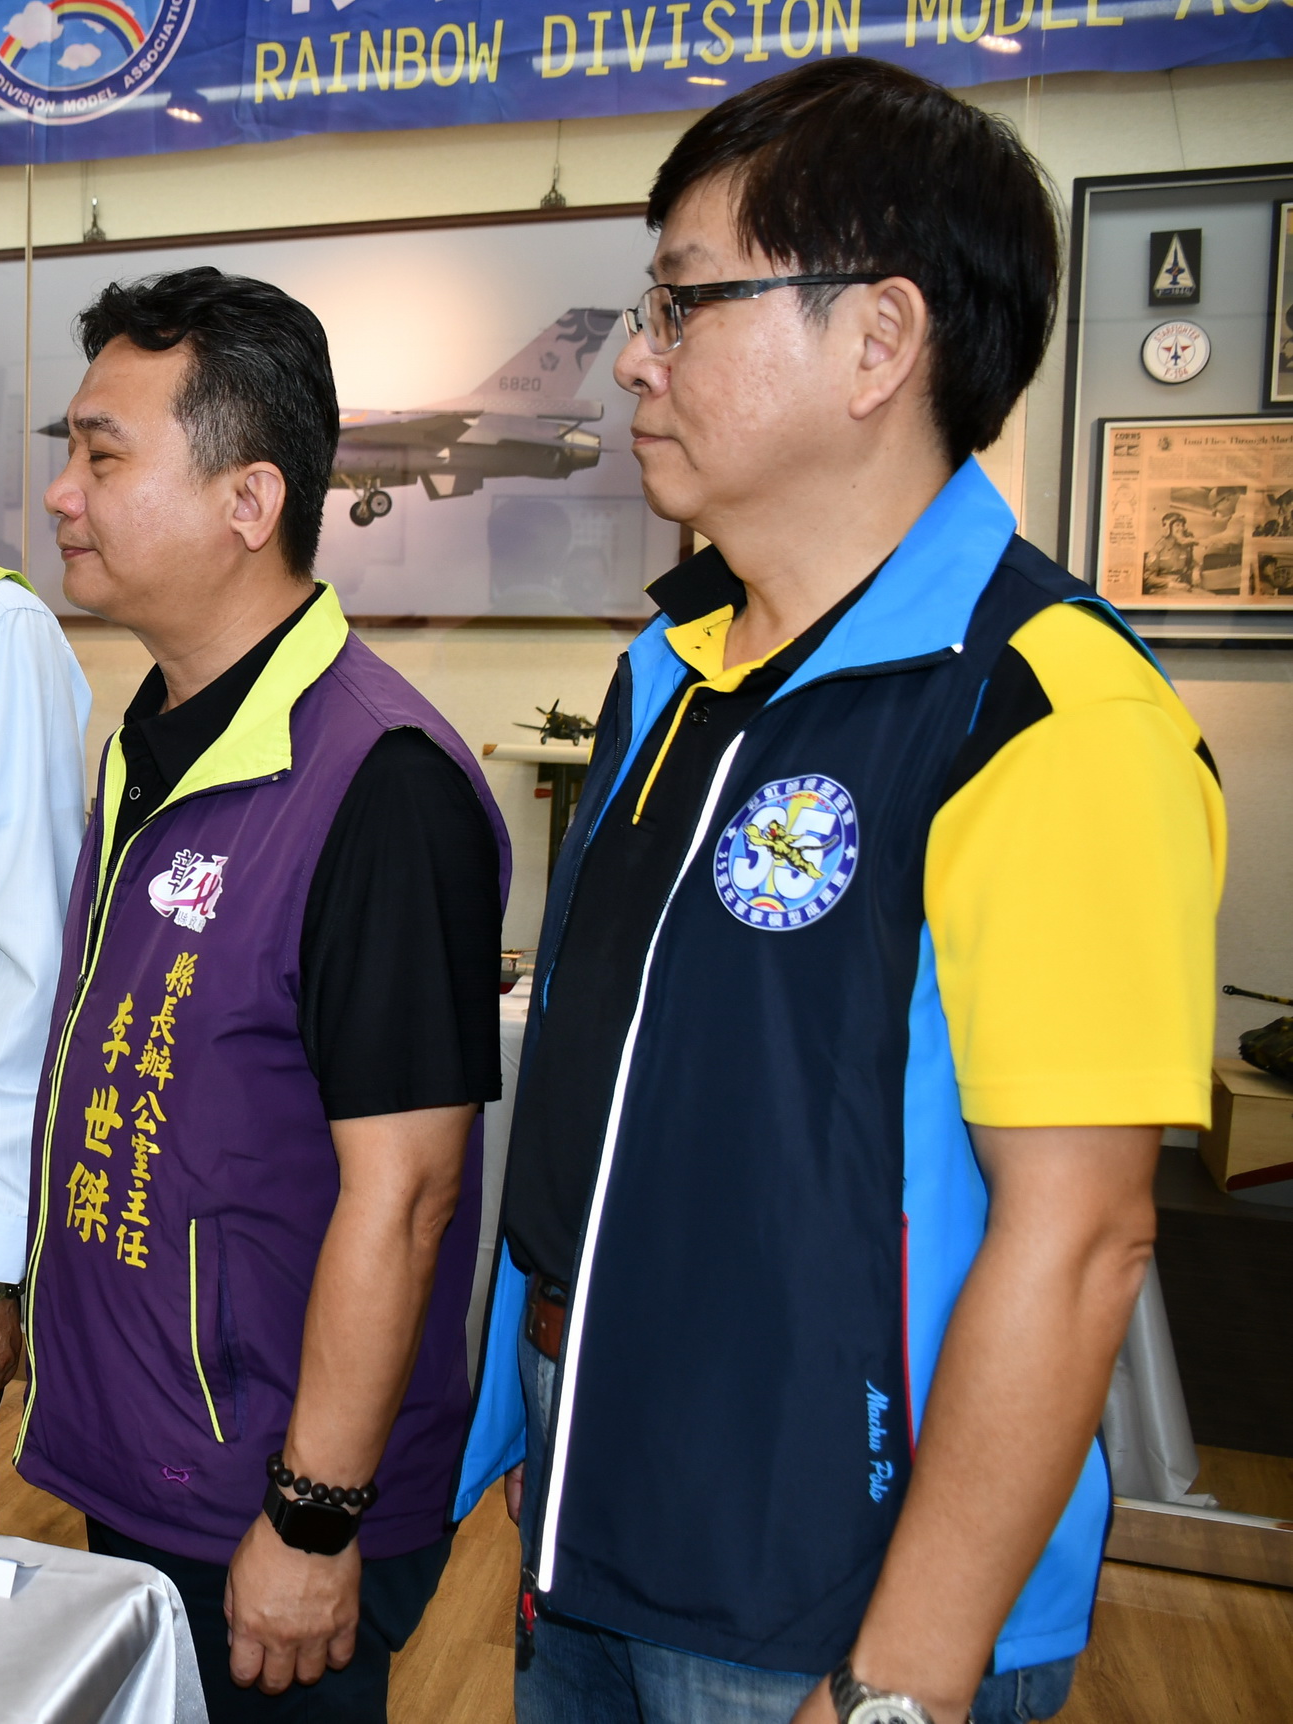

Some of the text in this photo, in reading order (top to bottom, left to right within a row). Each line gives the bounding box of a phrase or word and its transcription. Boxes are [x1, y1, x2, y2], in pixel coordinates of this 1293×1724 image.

[254, 19, 504, 103] RAINBOW
[541, 0, 861, 79] DIVISION
[63, 87, 118, 113] MODEL
[499, 377, 542, 392] 6820
[65, 992, 134, 1243] 李世傑
[115, 952, 199, 1269] 縣長辦公室主任
[868, 1459, 894, 1503] Polo
